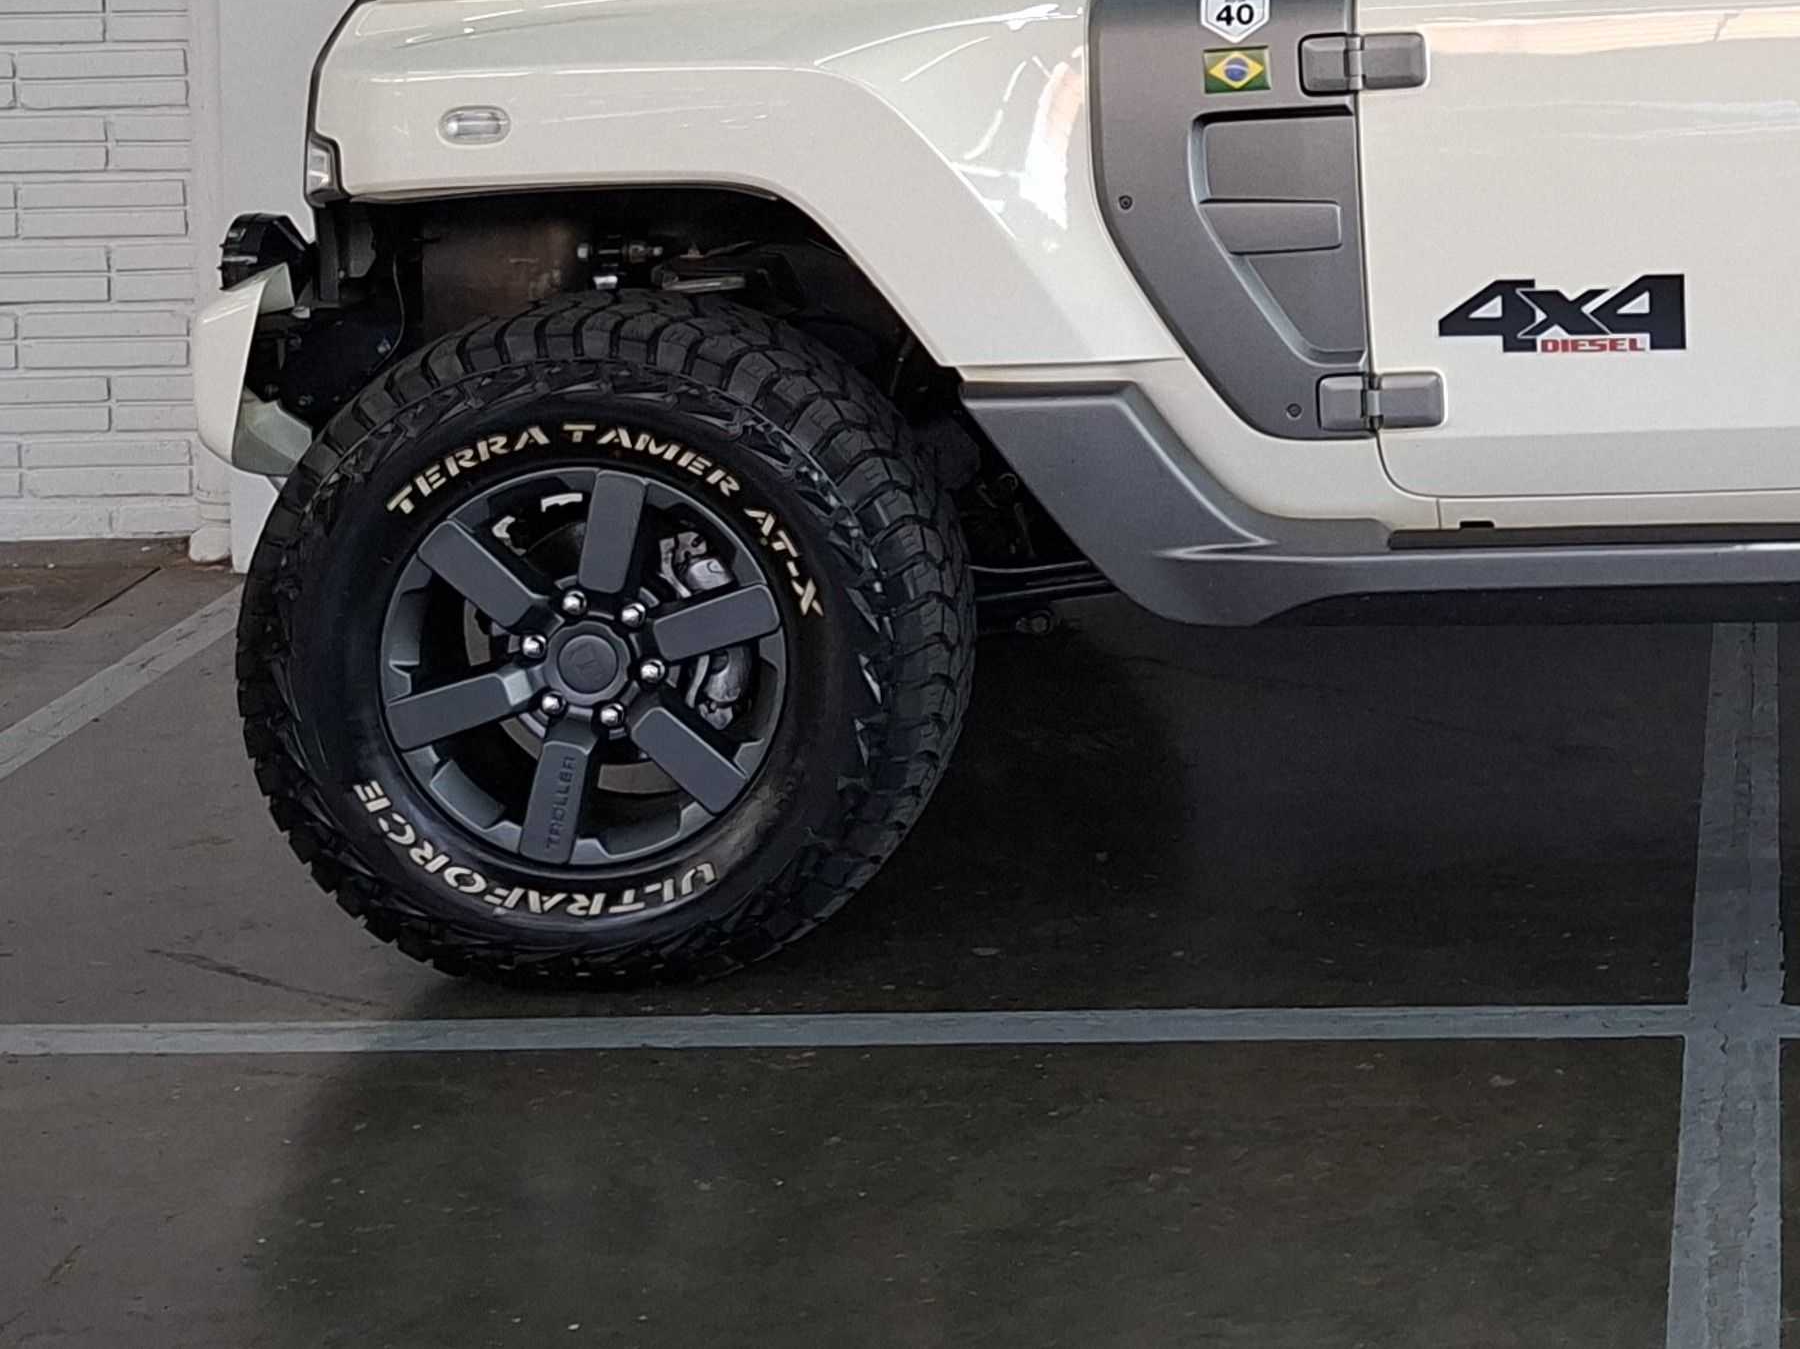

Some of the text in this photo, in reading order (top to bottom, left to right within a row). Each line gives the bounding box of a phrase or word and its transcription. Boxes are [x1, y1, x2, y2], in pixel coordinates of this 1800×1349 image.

[1215, 3, 1255, 27] 40
[1540, 337, 1647, 353] DIESEL
[385, 422, 826, 619] TERRA TAMER AT-X
[352, 778, 720, 918] ULTRAFORCE
[544, 755, 577, 850] TROLLER
